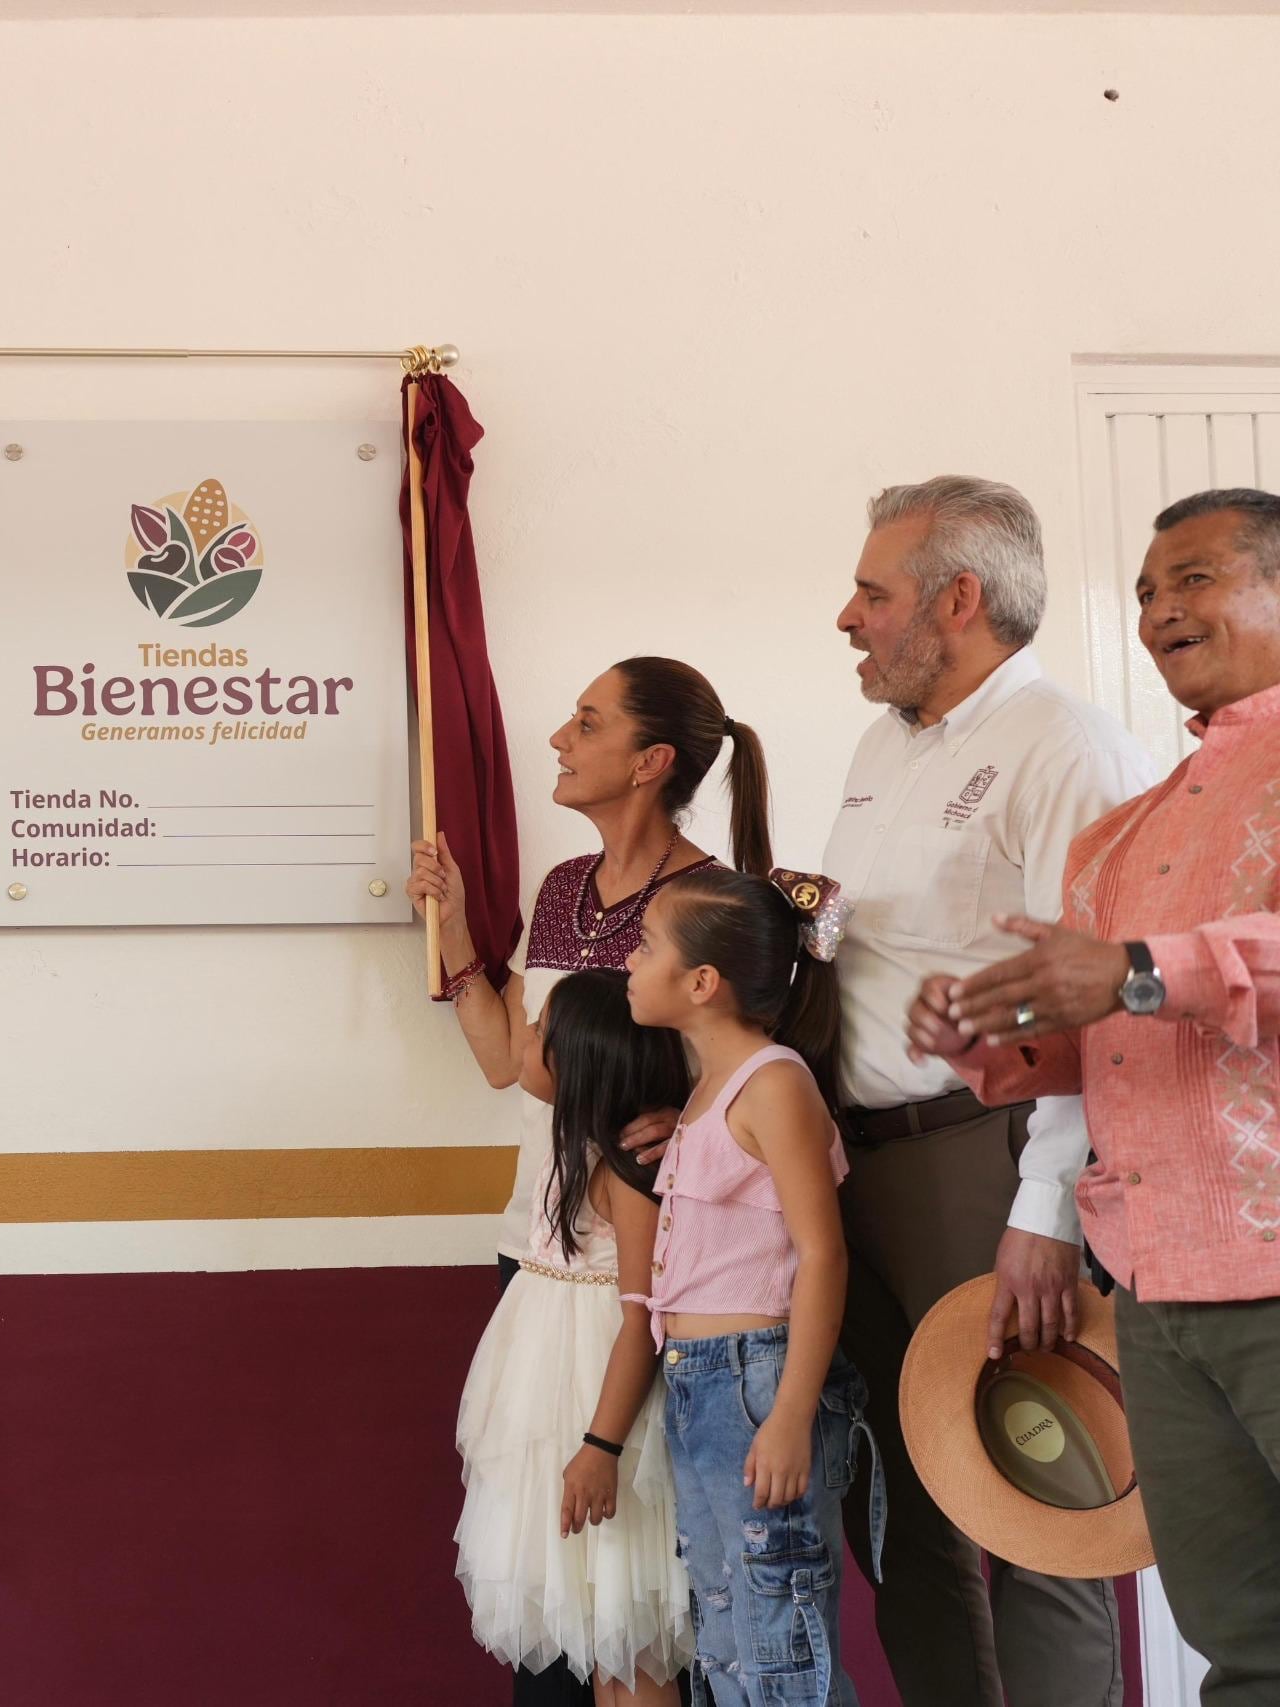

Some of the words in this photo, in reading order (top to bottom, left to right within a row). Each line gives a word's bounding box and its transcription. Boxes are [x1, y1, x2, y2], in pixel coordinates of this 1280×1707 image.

[138, 643, 248, 667] Tiendas
[32, 662, 354, 717] Bienestar
[81, 722, 206, 741] Generamos
[208, 720, 308, 745] felicidad
[10, 788, 91, 809] Tienda
[99, 789, 140, 809] No.
[11, 817, 157, 838] Comunidad:
[12, 847, 110, 867] Horario:
[1015, 1418, 1053, 1447] CUADRA
